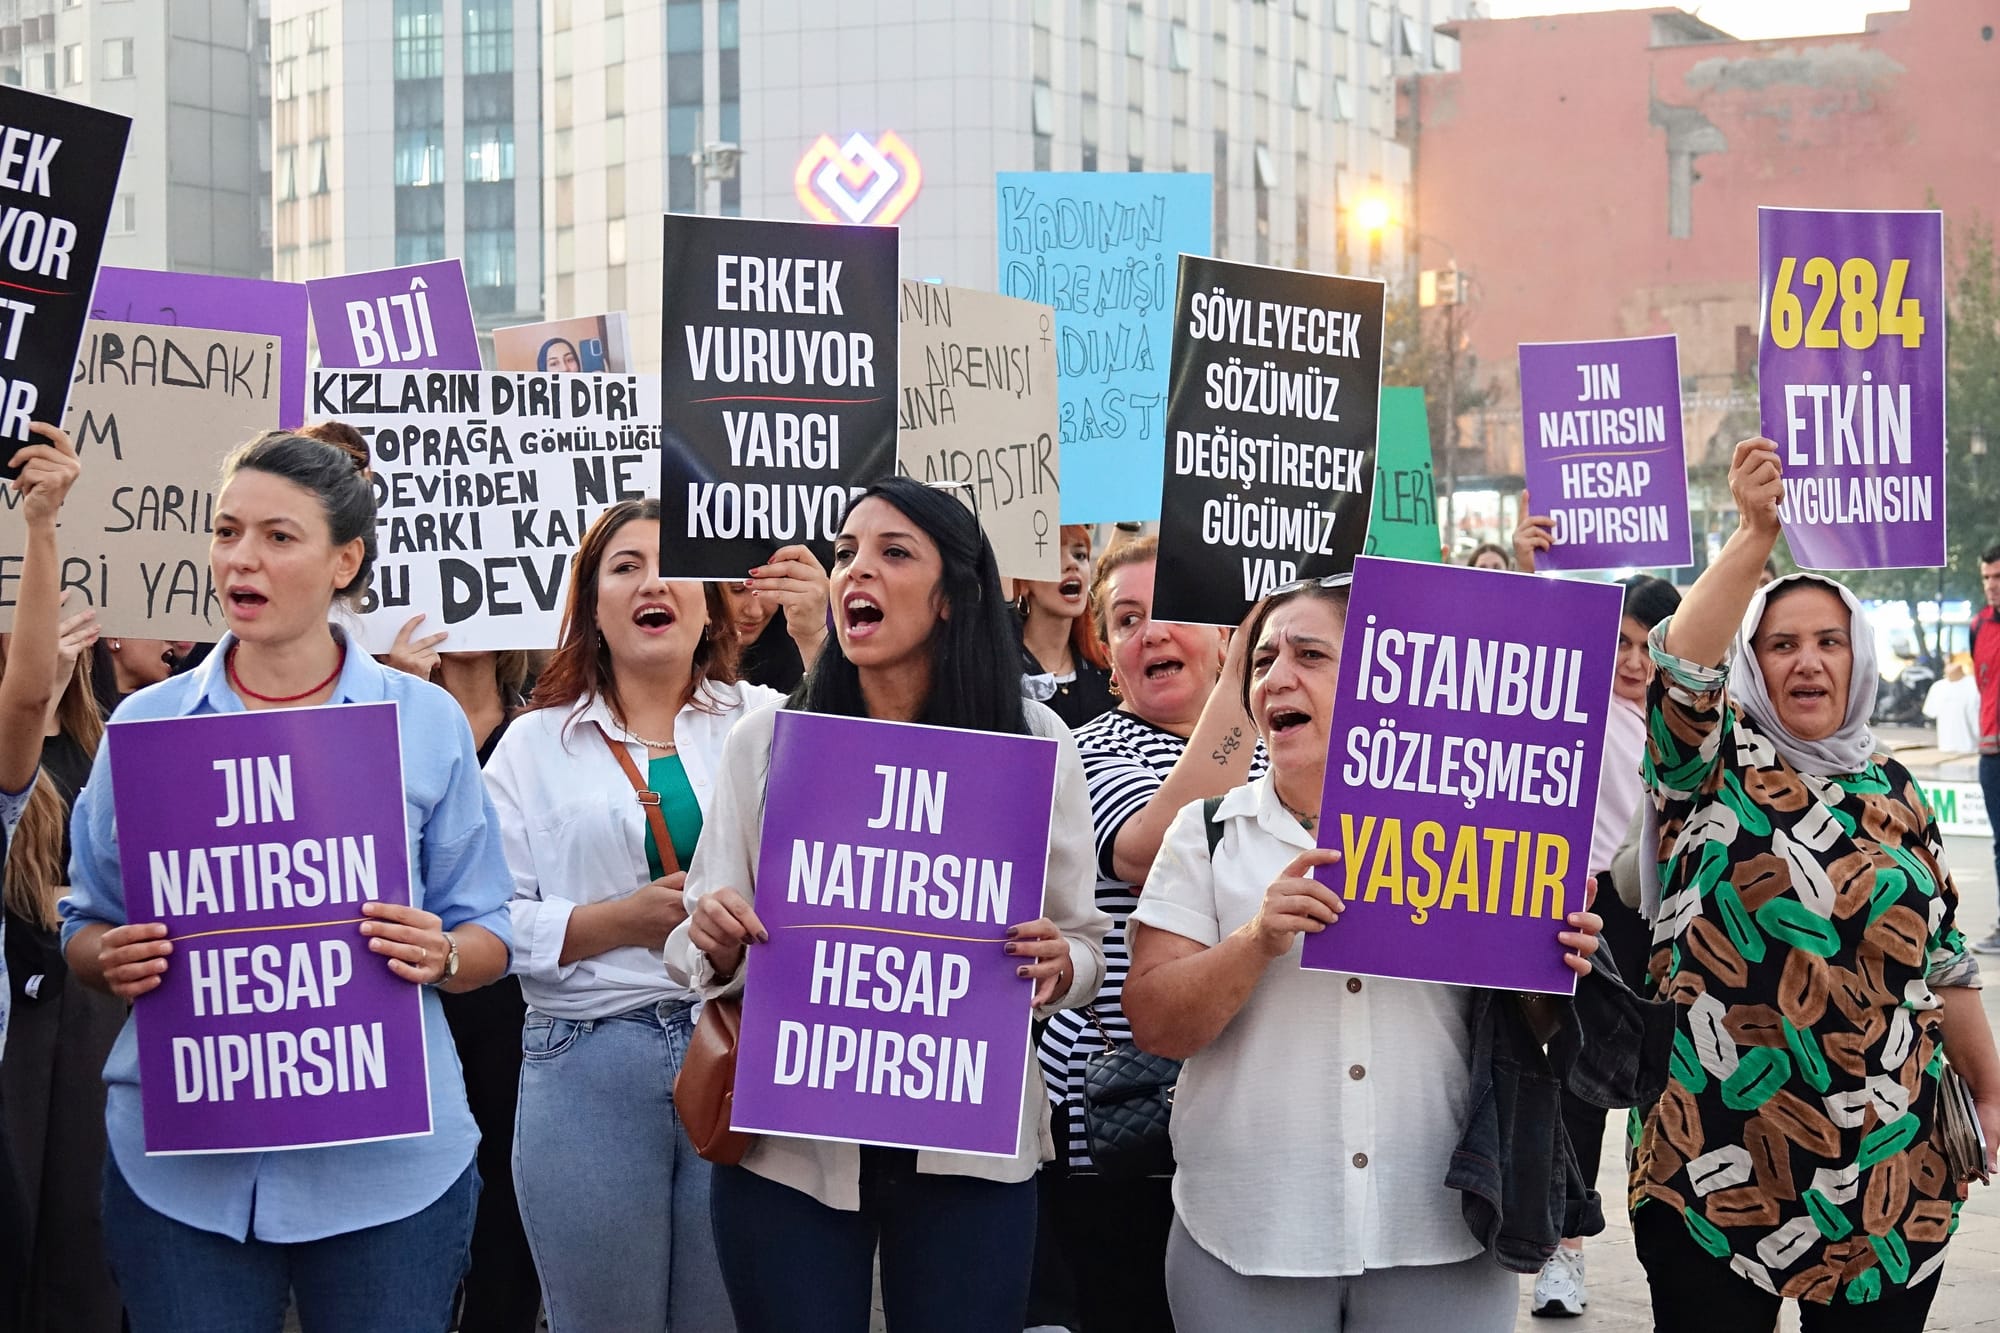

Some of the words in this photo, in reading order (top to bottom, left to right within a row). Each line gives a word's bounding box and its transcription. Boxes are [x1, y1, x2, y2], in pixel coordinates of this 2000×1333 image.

[0, 125, 63, 198] EK
[1002, 187, 1166, 254] KADININ
[716, 254, 844, 316] ERKEK
[899, 283, 952, 328] NIN
[1769, 256, 1925, 350] 6284
[345, 276, 438, 367] BIJÎ
[1057, 324, 1155, 384] DINA
[1189, 286, 1362, 359] SÖYLEYECEK
[685, 325, 875, 388] VURUYOR
[1205, 357, 1340, 423] SÖZÜMÜZ
[1576, 364, 1621, 402] JIN
[313, 371, 480, 415] KIZLARIN
[491, 374, 561, 419] DİRİ
[571, 376, 639, 421] DİRİ
[1059, 388, 1168, 445] RAST
[1539, 405, 1666, 448] NATIRSIN
[1784, 370, 1912, 467] ETKİN
[722, 410, 840, 470] YARGI
[1175, 425, 1365, 494] DEĞİŞTİRECEK
[573, 454, 646, 506] NE
[687, 482, 868, 541] KORUYO
[1377, 462, 1437, 526] LERİ
[1561, 461, 1651, 501] HESAP
[1202, 493, 1336, 556] GÜCÜMÜZ
[1550, 505, 1669, 546] DIPIRSIN
[438, 554, 567, 625] DEV
[1356, 614, 1589, 724] İSTANBUL
[213, 754, 296, 827] JIN
[1342, 718, 1585, 809] SÖZLEŞMESİ
[867, 764, 948, 834] JIN
[148, 834, 379, 917] NATIRSIN
[786, 838, 1013, 925] NATIRSIN
[1340, 813, 1571, 925] YAŞATIR
[188, 939, 352, 1017] HESAP
[809, 940, 970, 1018] HESAP
[172, 1022, 388, 1104] DIPIRSIN
[773, 1020, 988, 1105] DIPIRSIN
